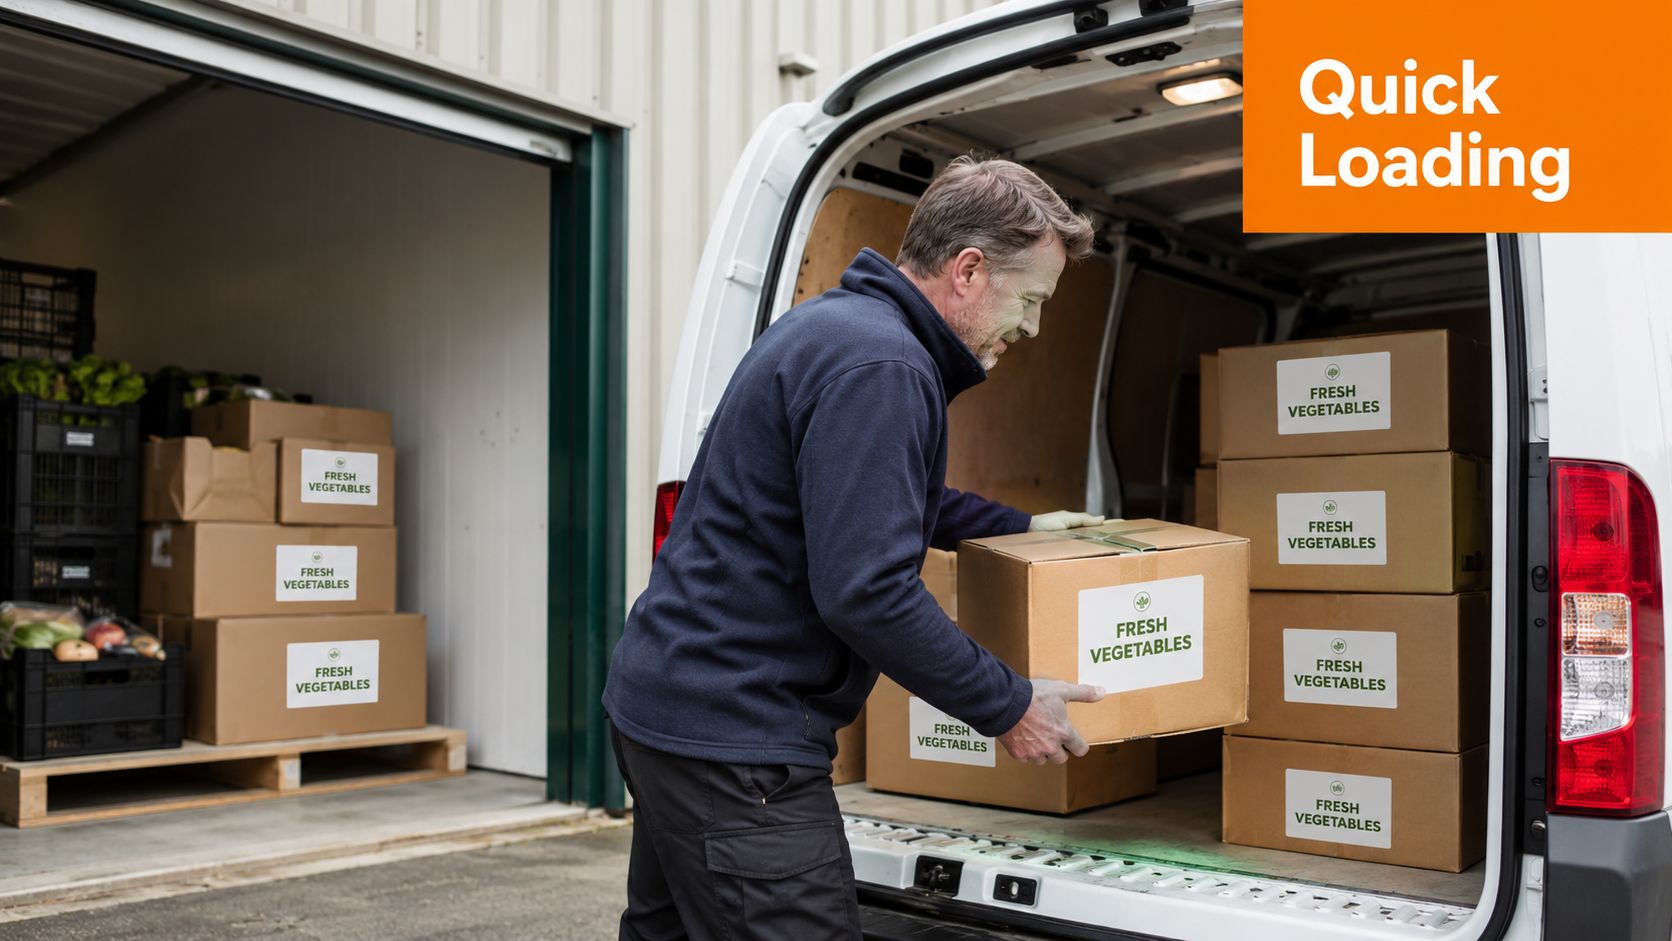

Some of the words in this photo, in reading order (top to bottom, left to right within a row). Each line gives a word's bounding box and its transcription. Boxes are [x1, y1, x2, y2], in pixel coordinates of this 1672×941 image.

[1310, 385, 1356, 400] FRESH
[1288, 400, 1380, 418] VEGETABLES
[324, 471, 357, 482] FRESH
[308, 482, 371, 494] VEGETABLES
[1308, 521, 1353, 533] FRESH
[1287, 537, 1377, 550] VEGETABLES
[300, 567, 335, 577] FRESH
[283, 579, 350, 590] VEGETABLES
[1116, 616, 1168, 639] FRESH
[1090, 634, 1192, 664] VEGETABLES
[315, 665, 353, 679] FRESH
[1316, 658, 1363, 674] FRESH
[295, 679, 371, 694] VEGETABLES
[1293, 673, 1387, 692] VEGETABLES
[934, 724, 970, 737] FRESH
[917, 736, 988, 753] VEGETABLES
[1316, 798, 1360, 815] FRESH
[1294, 811, 1382, 833] VEGETABLES
